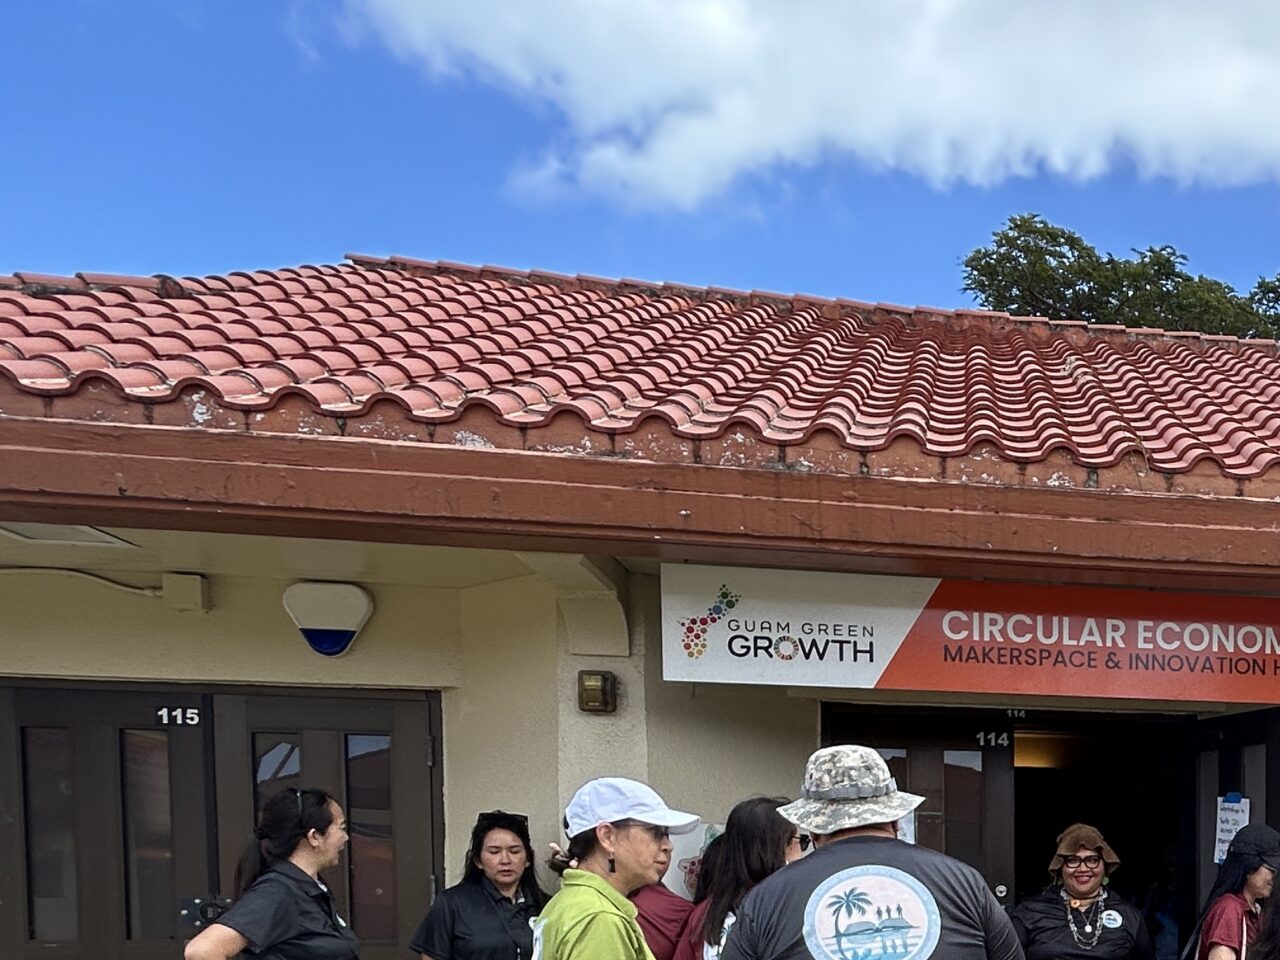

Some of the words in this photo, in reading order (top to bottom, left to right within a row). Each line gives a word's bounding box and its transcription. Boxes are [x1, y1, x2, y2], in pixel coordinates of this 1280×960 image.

[727, 619, 790, 634] GUAM
[801, 622, 874, 637] GREEN
[942, 610, 1126, 648] CIRCULAR
[727, 634, 874, 662] GROWTH
[943, 644, 1098, 669] MAKERSPACE
[1104, 651, 1122, 670] &
[1128, 653, 1266, 675] INNOVATION
[157, 707, 200, 725] 115
[1006, 709, 1026, 718] 114
[976, 731, 1009, 747] 114
